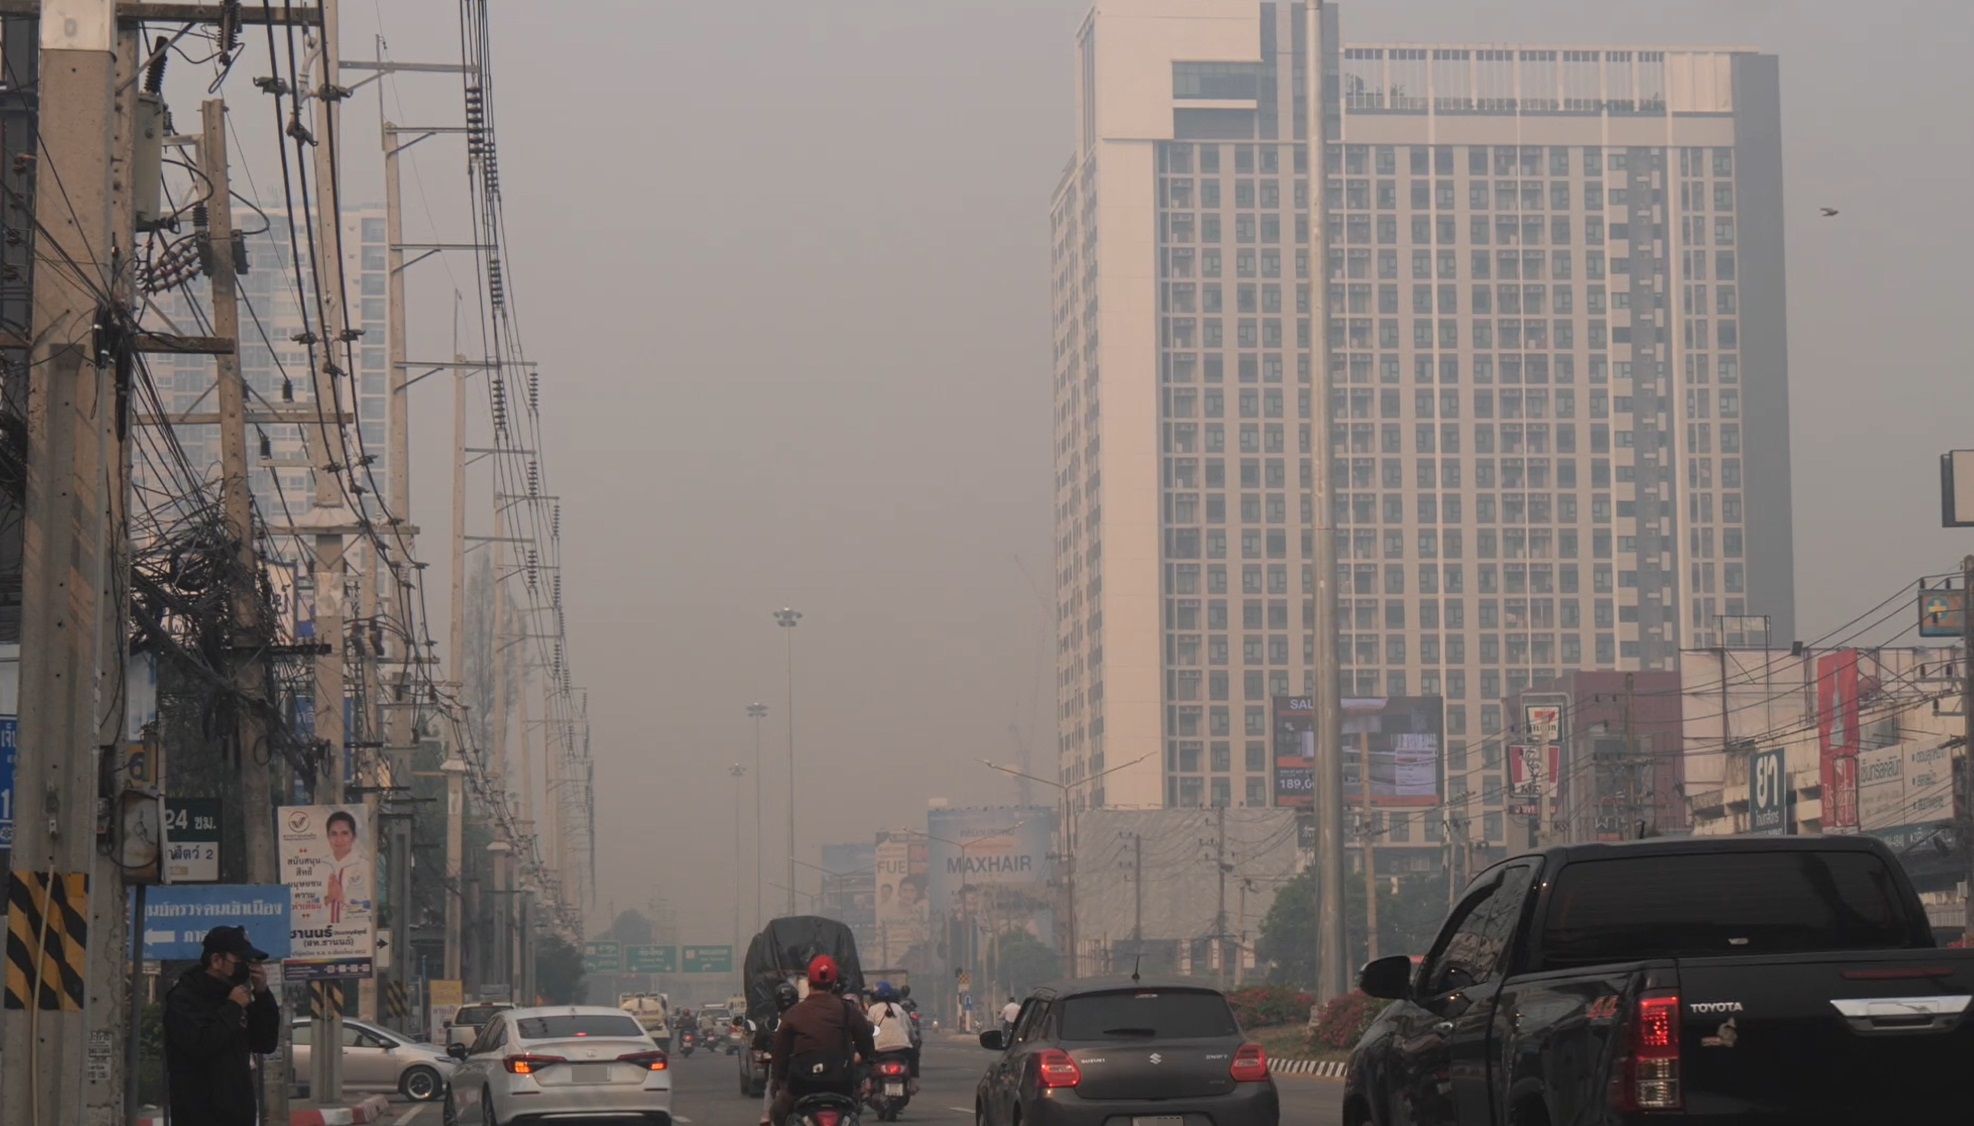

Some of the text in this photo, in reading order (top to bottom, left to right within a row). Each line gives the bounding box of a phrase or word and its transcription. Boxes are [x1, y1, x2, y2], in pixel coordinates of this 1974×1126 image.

[1756, 754, 1778, 809] ยา
[166, 809, 217, 830] 24 ขม.
[206, 850, 214, 860] 2
[877, 860, 907, 874] FUE
[947, 855, 1032, 873] MAXHAIR
[1690, 1002, 1743, 1014] TOYOTA
